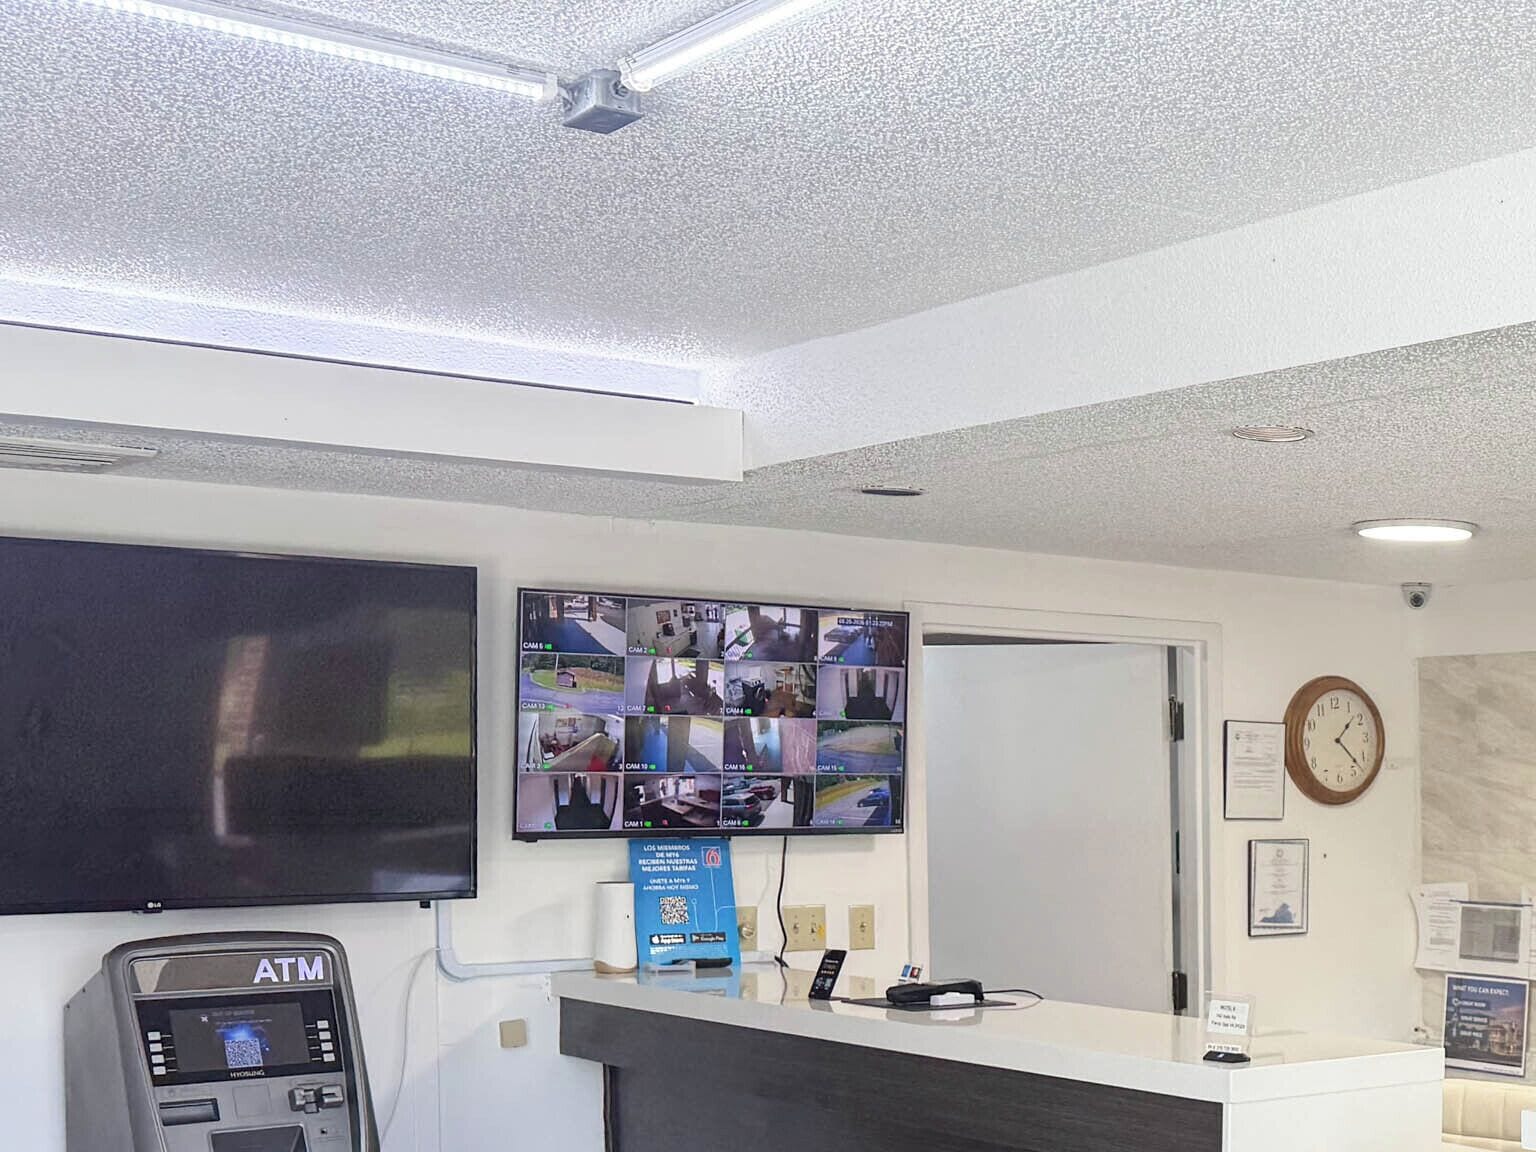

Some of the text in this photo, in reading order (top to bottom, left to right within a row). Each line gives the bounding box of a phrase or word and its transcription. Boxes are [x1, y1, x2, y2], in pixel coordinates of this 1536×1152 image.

[523, 642, 539, 650] CAM
[1330, 697, 1339, 709] 12
[1317, 703, 1324, 717] 11
[1307, 719, 1316, 732] 10
[1357, 713, 1363, 726] 2
[253, 956, 324, 984] ATM
[230, 1070, 264, 1078] HYOSUNG
